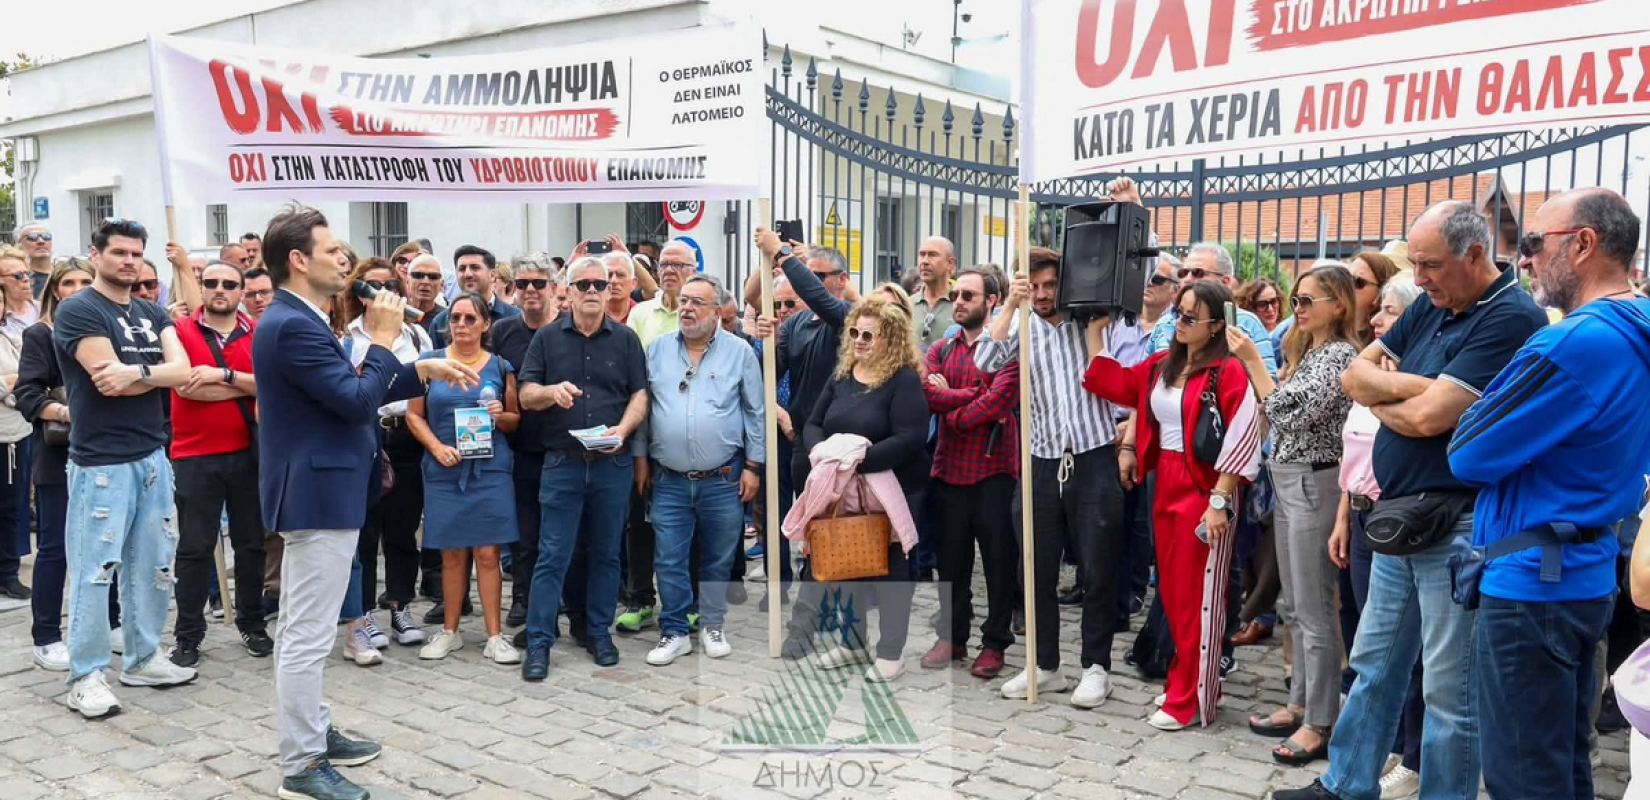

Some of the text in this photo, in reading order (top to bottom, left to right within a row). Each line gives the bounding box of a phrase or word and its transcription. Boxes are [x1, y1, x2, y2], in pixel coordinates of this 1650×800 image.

[1270, 0, 1314, 35] ΣΤΟ
[336, 72, 415, 104] ΣΤΗΝ
[421, 60, 618, 106] ΑΜΜΟΛΗΨΙΑ
[659, 59, 753, 83] Ο ΘΕΡΜΑΪΚΟΣ
[673, 84, 741, 103] ΔΕΝ ΕΙΝΑΙ
[391, 113, 489, 137] ΑΩΤΗΡΙ
[494, 113, 599, 138] ΕΠΑΝΟΜΗΣ
[671, 105, 744, 125] ΛΑΤΟΜΕΙΟ
[1073, 108, 1135, 161] ΚΑΤΩ
[1144, 102, 1175, 149] ΤΑ
[1186, 88, 1281, 145] ΧΕΡΙΑ
[1294, 79, 1368, 133] ΑΠΟ
[1383, 67, 1462, 124] ΤΗΝ
[228, 153, 707, 183] ΟΧΙ ΣΤΗΝ ΚΑΤΑΣΤΡΟΦΗ ΤΟΥ ΥΔΡΟΒΙΟΤΟΠΟΥ ΕΠΑΝΟΜΗΣ
